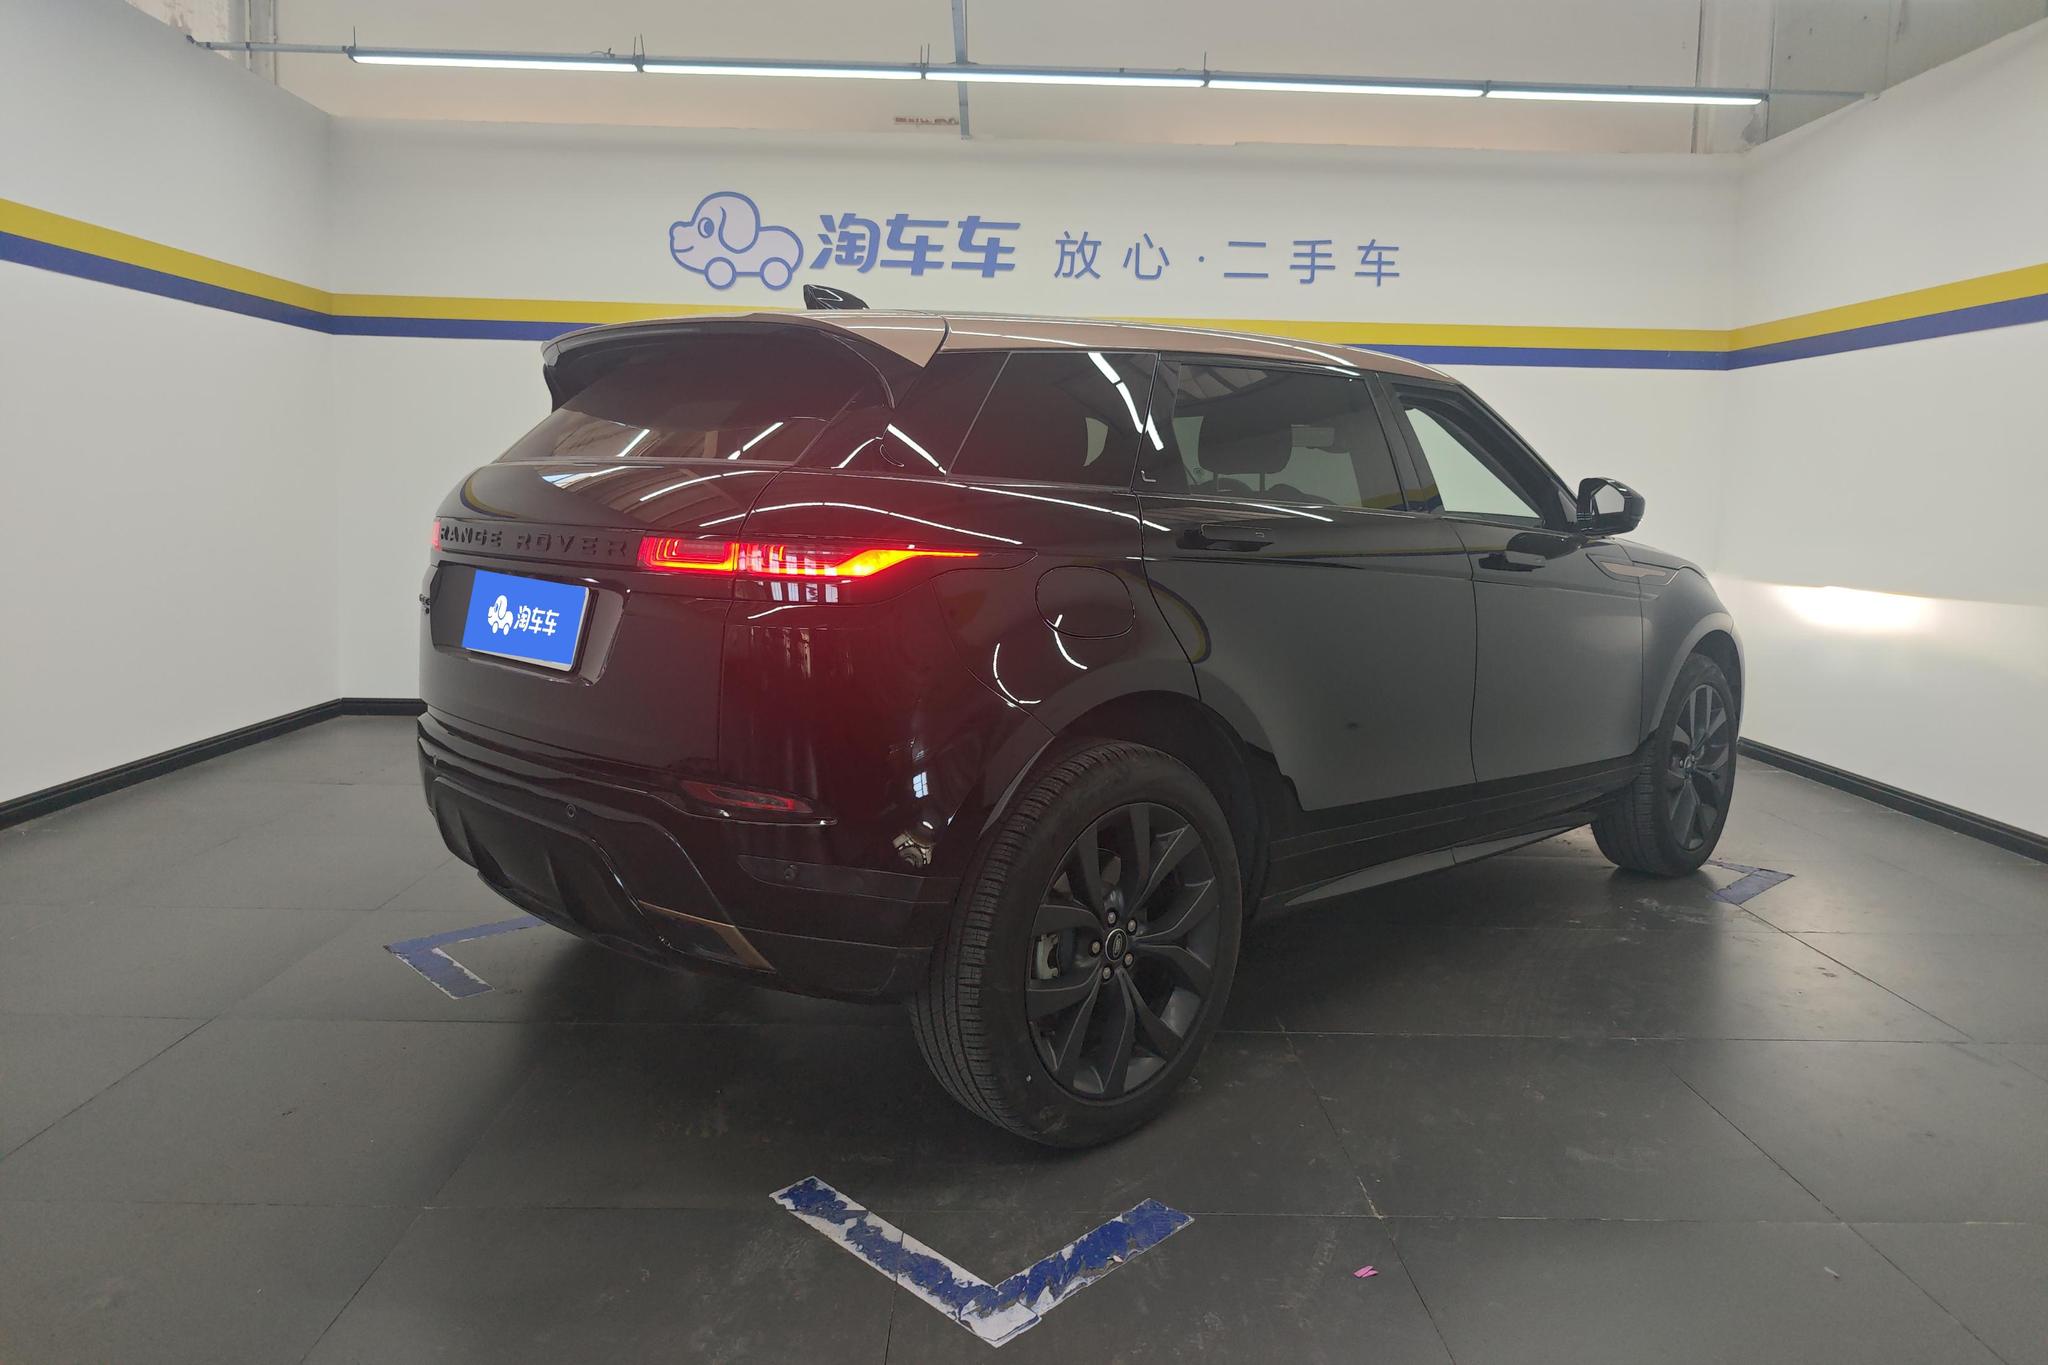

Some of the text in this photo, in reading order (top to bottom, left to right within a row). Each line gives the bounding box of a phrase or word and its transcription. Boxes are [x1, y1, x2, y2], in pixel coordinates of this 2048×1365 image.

[809, 212, 1021, 279] 淘车车
[1054, 230, 1401, 287] 放心·二手车
[440, 524, 628, 557] RANGE ROVER
